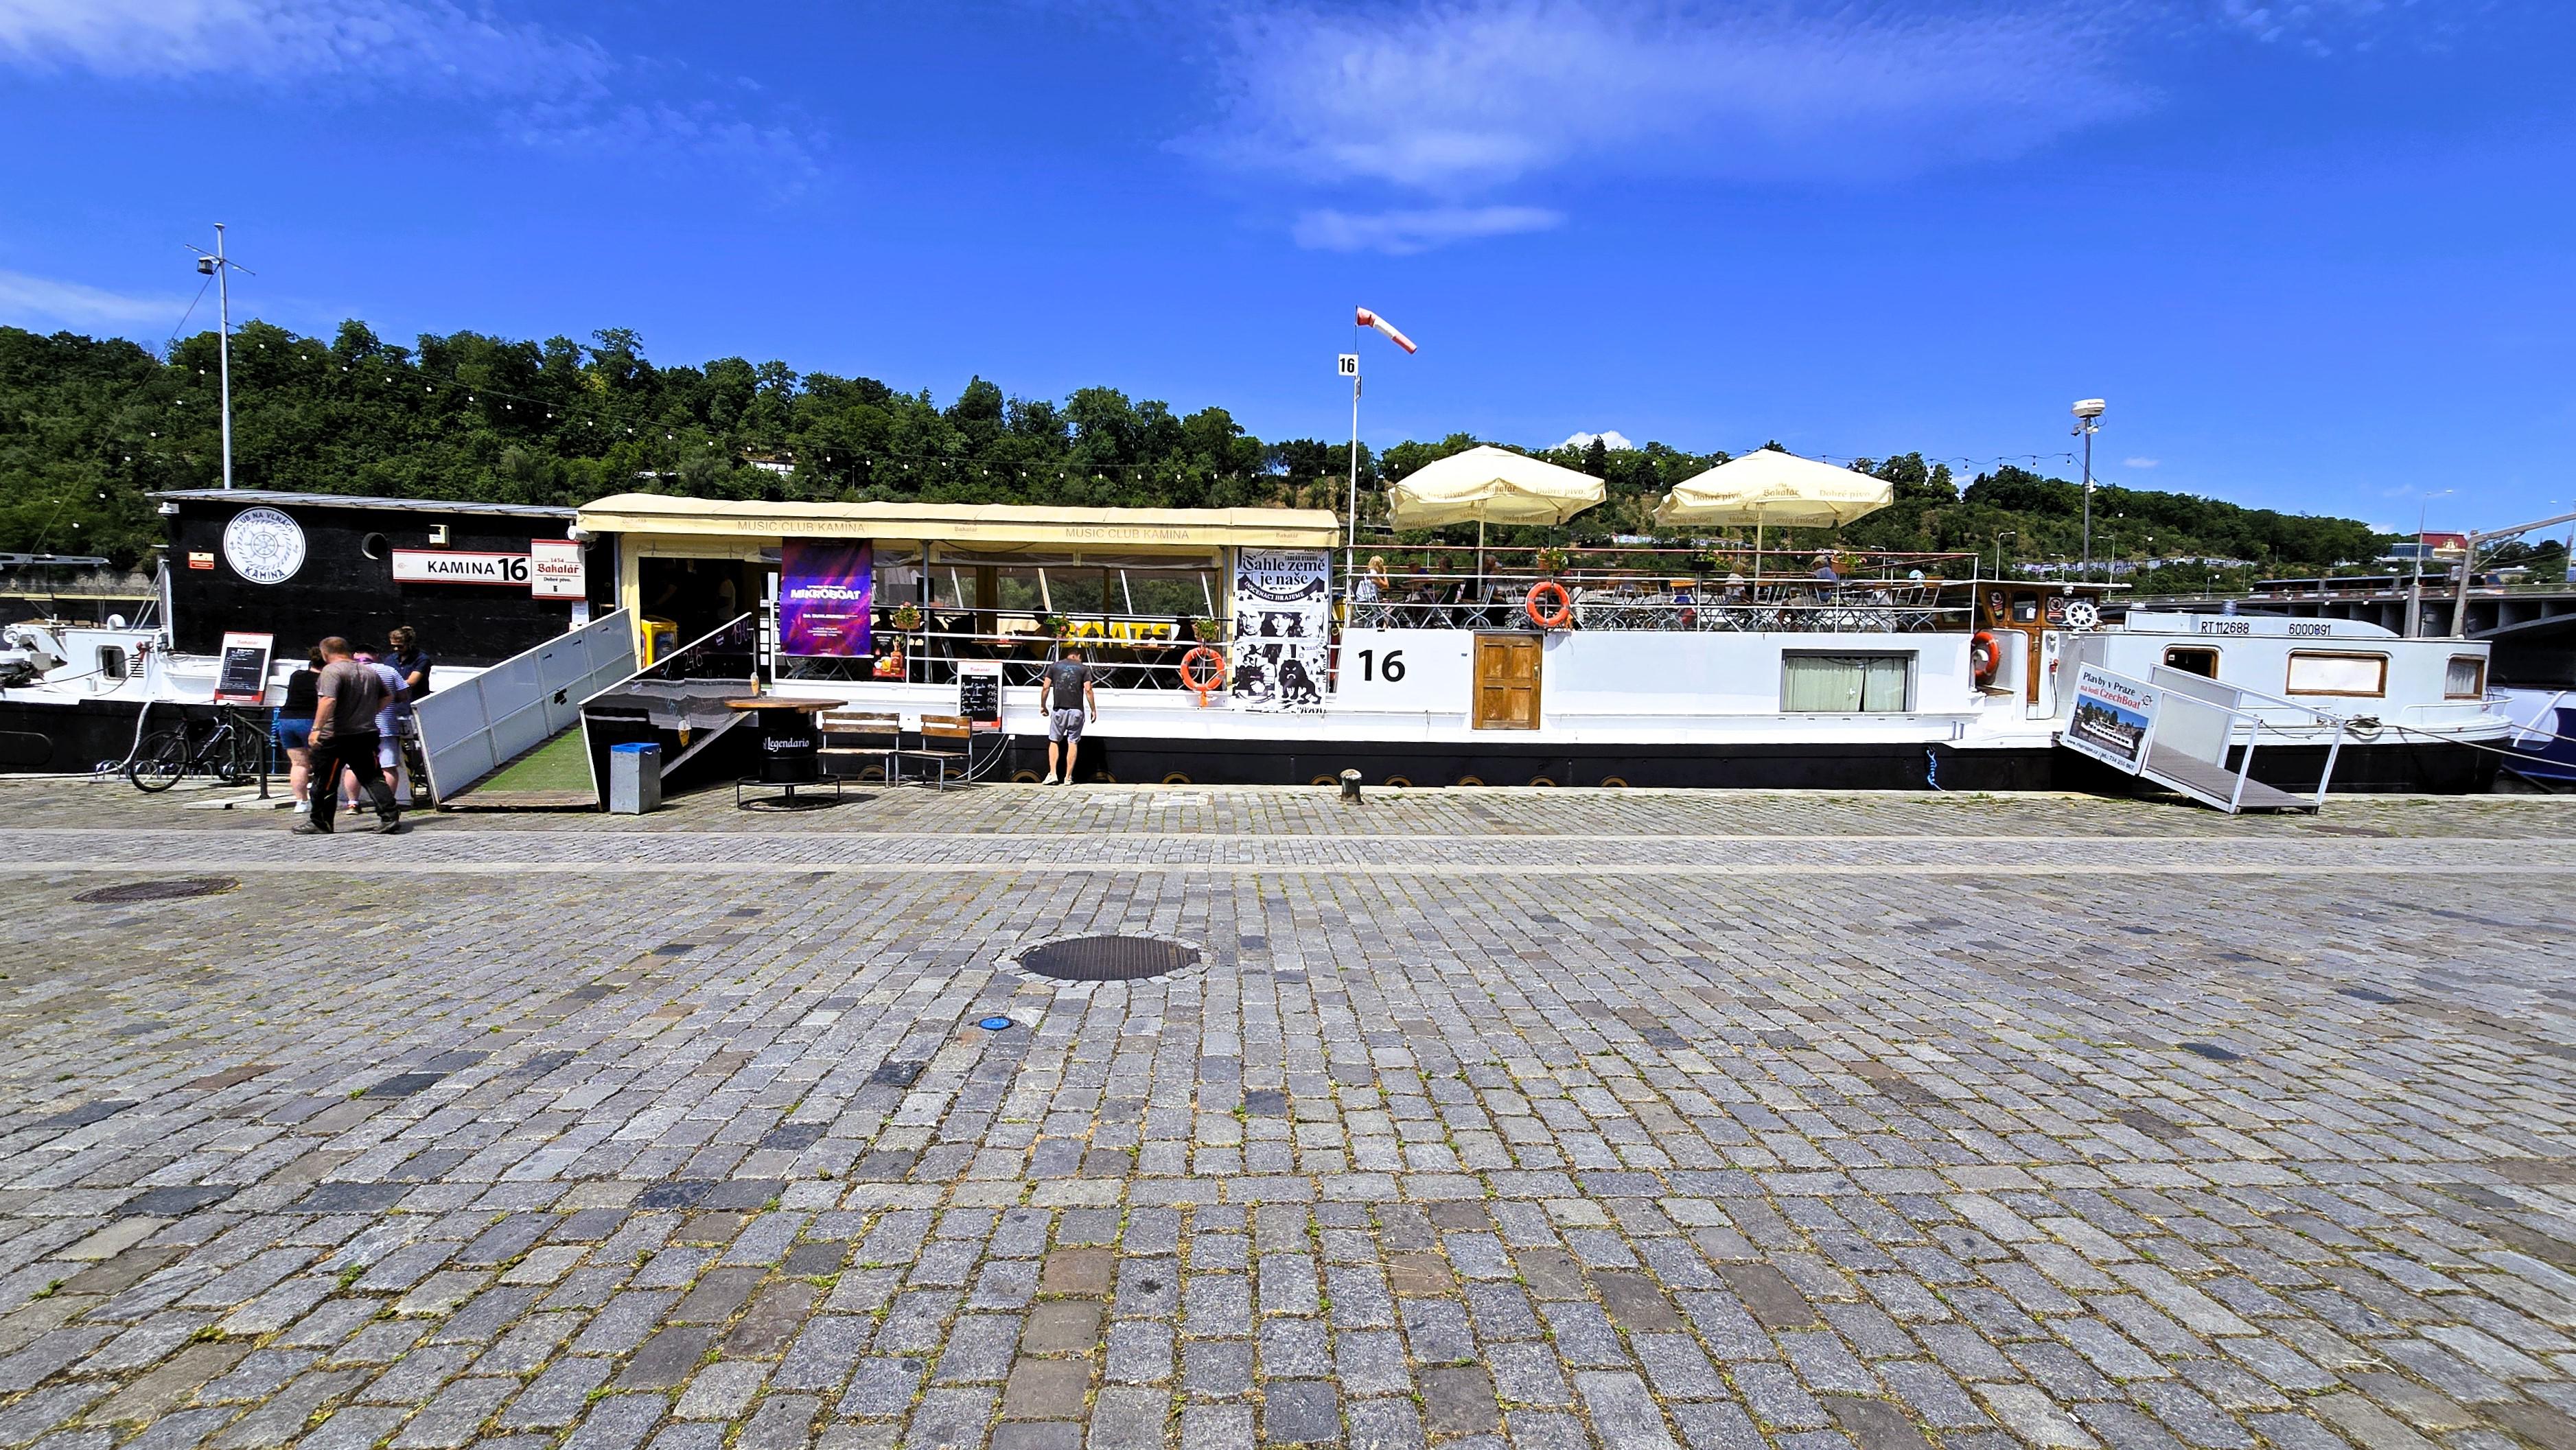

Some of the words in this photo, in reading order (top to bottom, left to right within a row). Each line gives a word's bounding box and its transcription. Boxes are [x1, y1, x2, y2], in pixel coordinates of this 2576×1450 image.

[1340, 358, 1355, 373] 16
[1850, 490, 1872, 499] pivo.
[233, 515, 251, 530] KLUB
[266, 512, 295, 533] VLNÁCH
[738, 521, 777, 531] MUSIC
[781, 522, 814, 532] CLUB
[818, 523, 866, 533] KAMINA
[1066, 528, 1104, 538] MUSIC
[1109, 528, 1139, 539] CLUB
[1144, 530, 1189, 539] KAMINA
[428, 561, 495, 575] KAMINA
[498, 557, 528, 581] 16
[537, 563, 579, 574] Bakalář
[1288, 557, 1325, 572] země
[244, 566, 286, 580] KAMINA
[1260, 572, 1273, 587] je
[1277, 572, 1308, 585] naše
[791, 589, 861, 600] MIKROBOAT
[1060, 620, 1171, 648] BOATS
[2201, 621, 2214, 633] RT
[2216, 622, 2250, 634] 112688
[2288, 624, 2331, 635] 6000891
[1358, 649, 1405, 682] 16
[2082, 672, 2107, 686] Plavby
[2113, 682, 2136, 697] Praze
[2100, 688, 2141, 710] CzechBoat
[767, 736, 809, 752] Legendario
